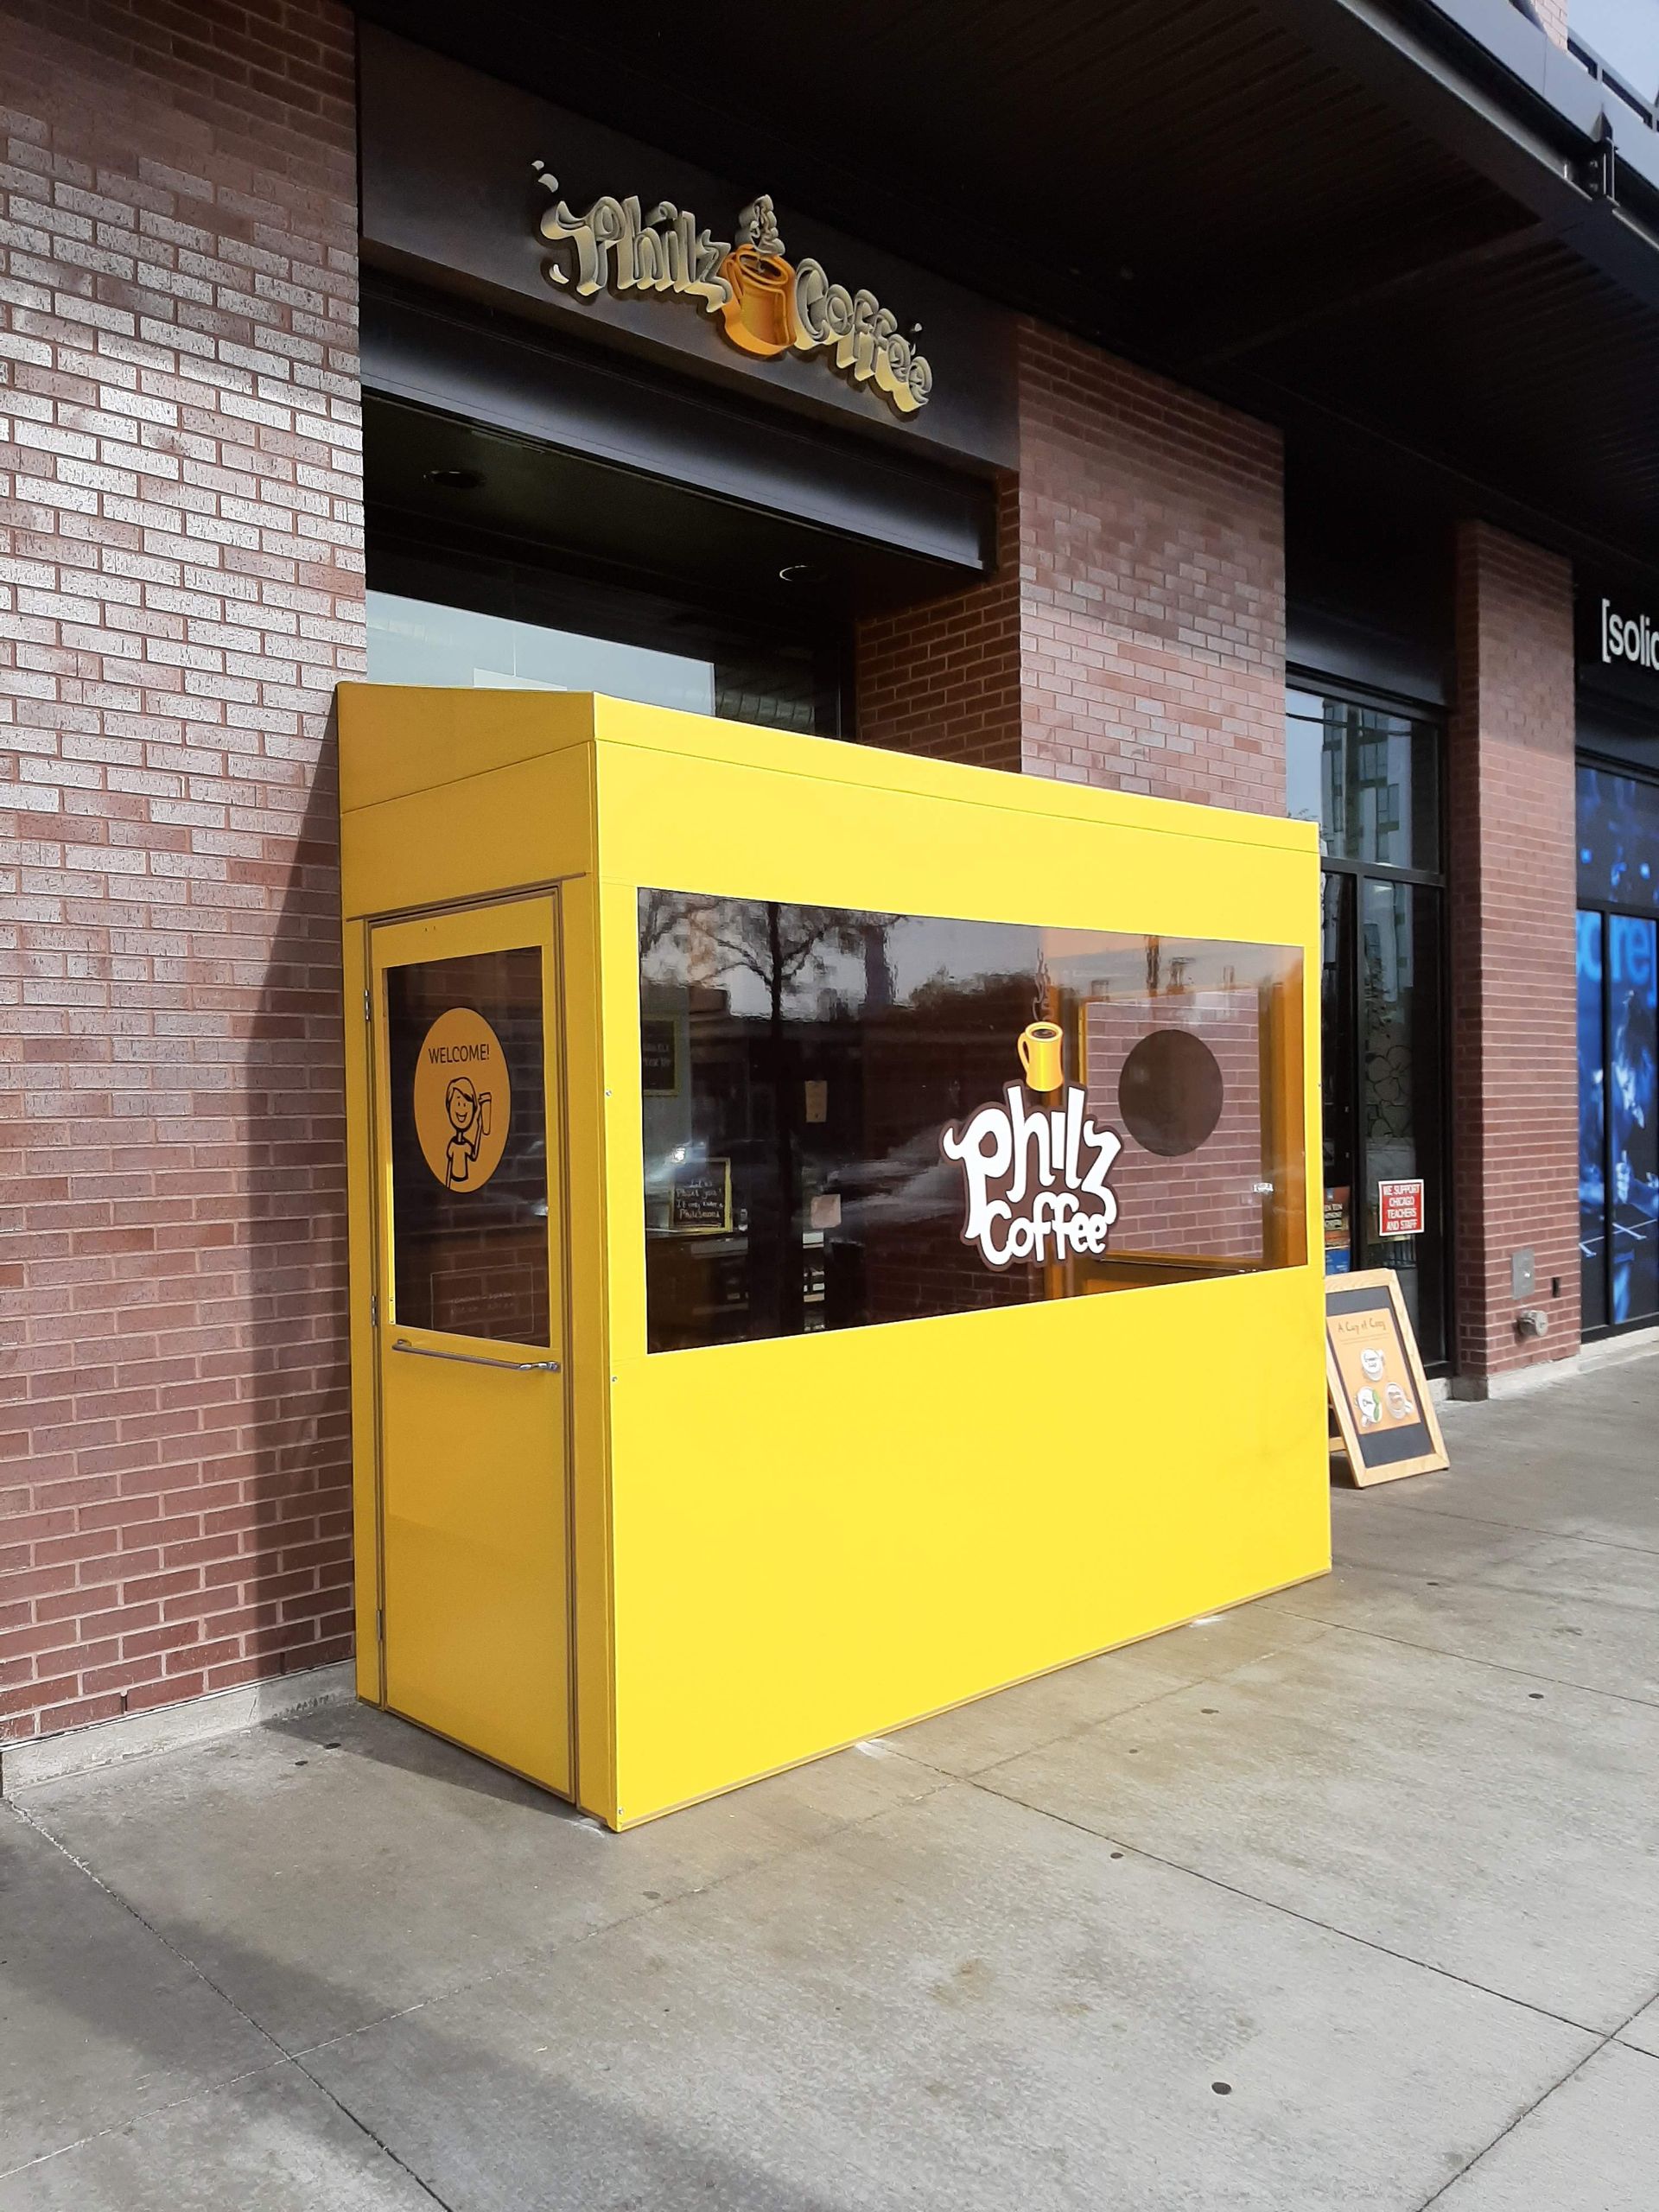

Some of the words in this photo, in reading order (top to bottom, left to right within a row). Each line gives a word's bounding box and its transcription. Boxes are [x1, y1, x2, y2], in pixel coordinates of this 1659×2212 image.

[539, 194, 734, 313] Philz
[793, 257, 933, 413] Coffee
[428, 1043, 490, 1064] WELCOME!
[1394, 1184, 1421, 1195] SUPPORT
[1389, 1196, 1414, 1207] CHICAGO
[1387, 1207, 1418, 1219] TEACHERS
[980, 1191, 1108, 1265] Coffee
[1386, 1220, 1400, 1231] AND
[1400, 1218, 1418, 1230] STAFF
[1338, 1322, 1344, 1332] A
